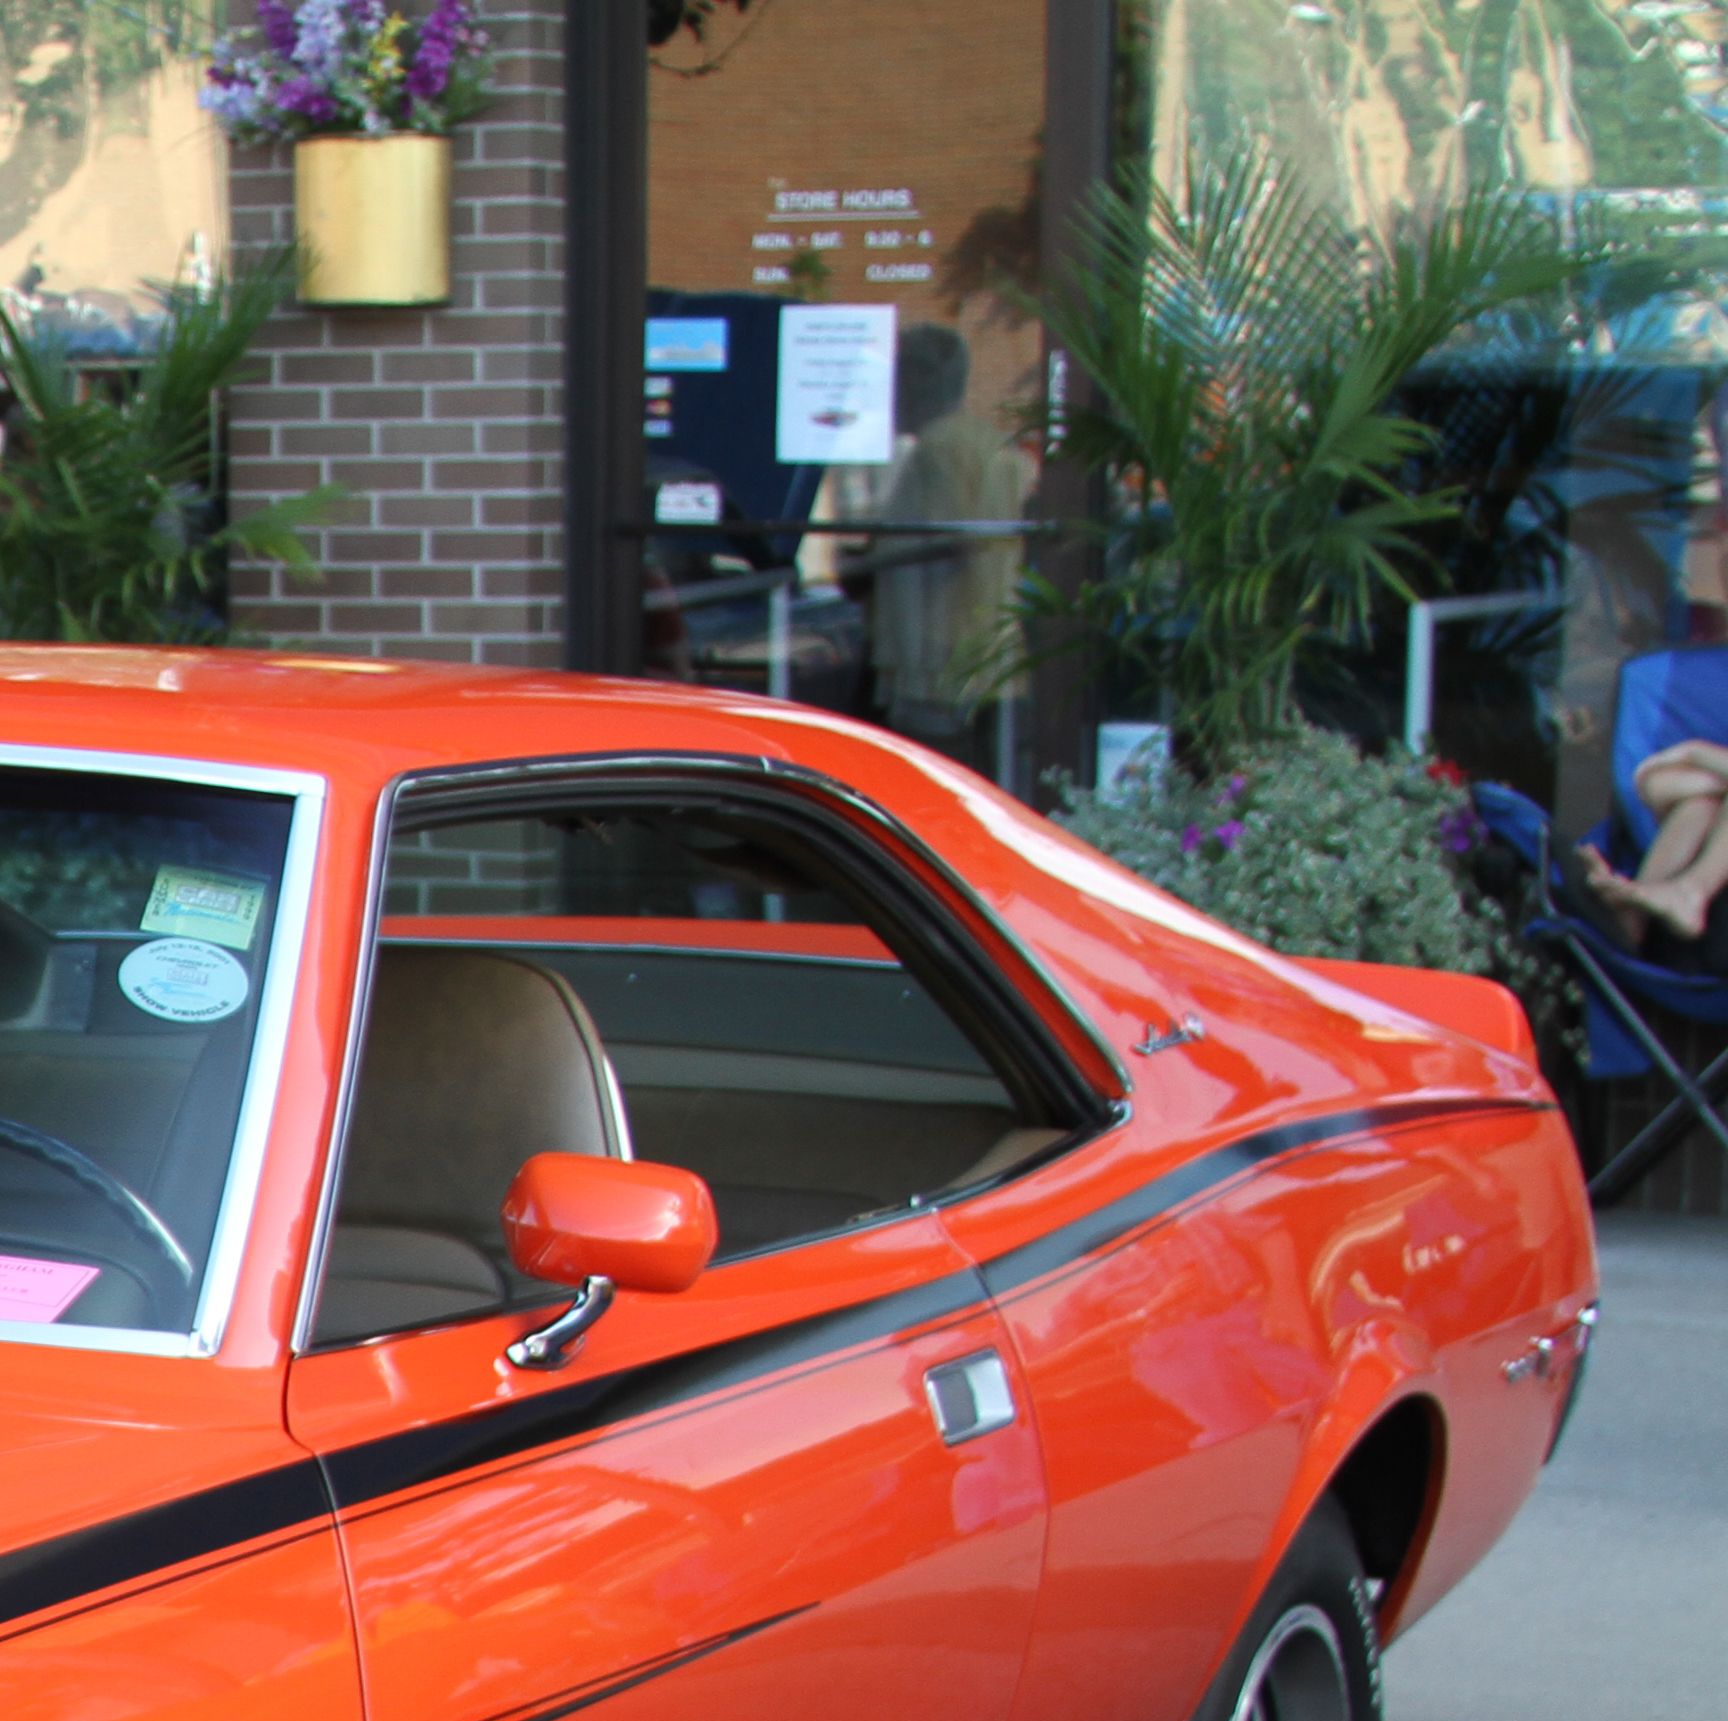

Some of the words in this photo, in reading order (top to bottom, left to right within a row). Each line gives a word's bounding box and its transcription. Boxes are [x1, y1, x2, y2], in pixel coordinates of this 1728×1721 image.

[775, 190, 839, 211] STORE
[842, 188, 911, 209] HOURS
[865, 264, 933, 282] CLOSED
[133, 985, 167, 1011] SHOW
[171, 1001, 230, 1016] VEHICLE
